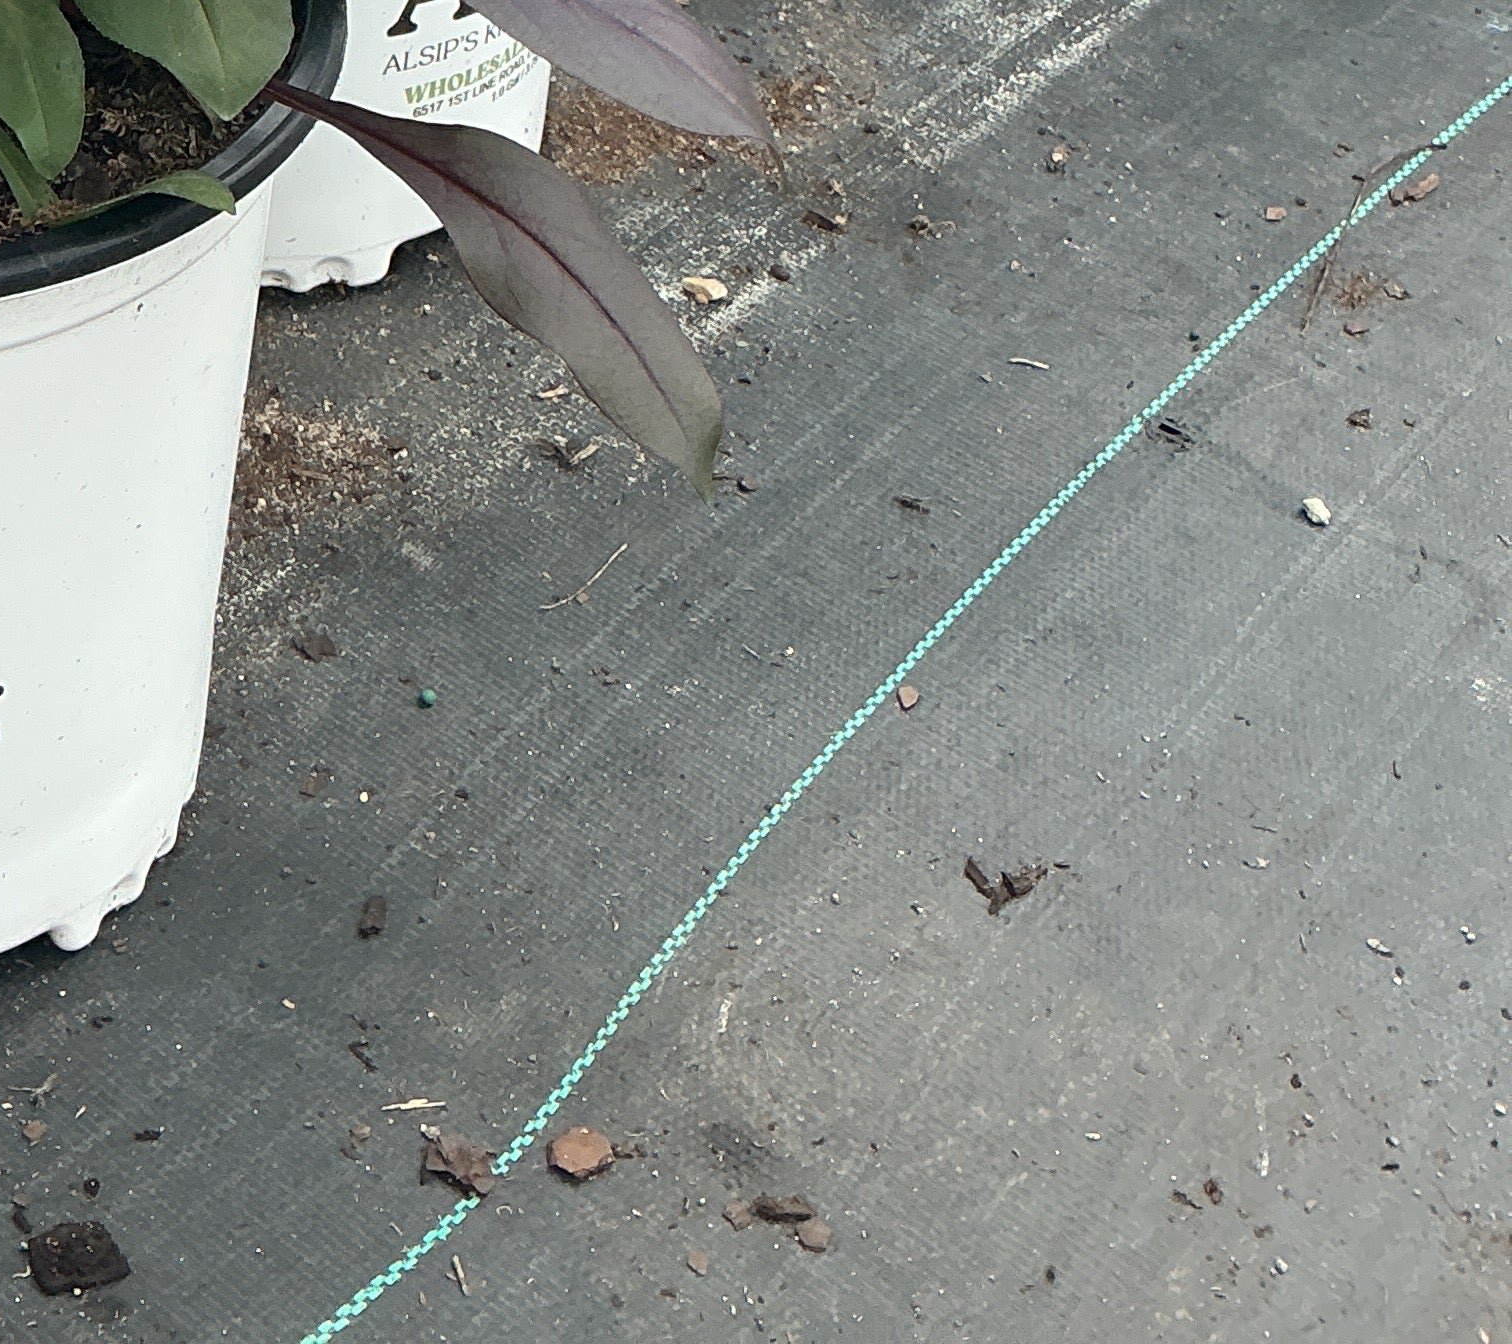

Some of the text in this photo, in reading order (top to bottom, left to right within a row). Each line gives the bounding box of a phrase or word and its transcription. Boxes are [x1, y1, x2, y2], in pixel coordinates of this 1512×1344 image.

[381, 29, 480, 76] ALSIP'S
[412, 99, 445, 118] 6517
[447, 90, 471, 108] 1ST
